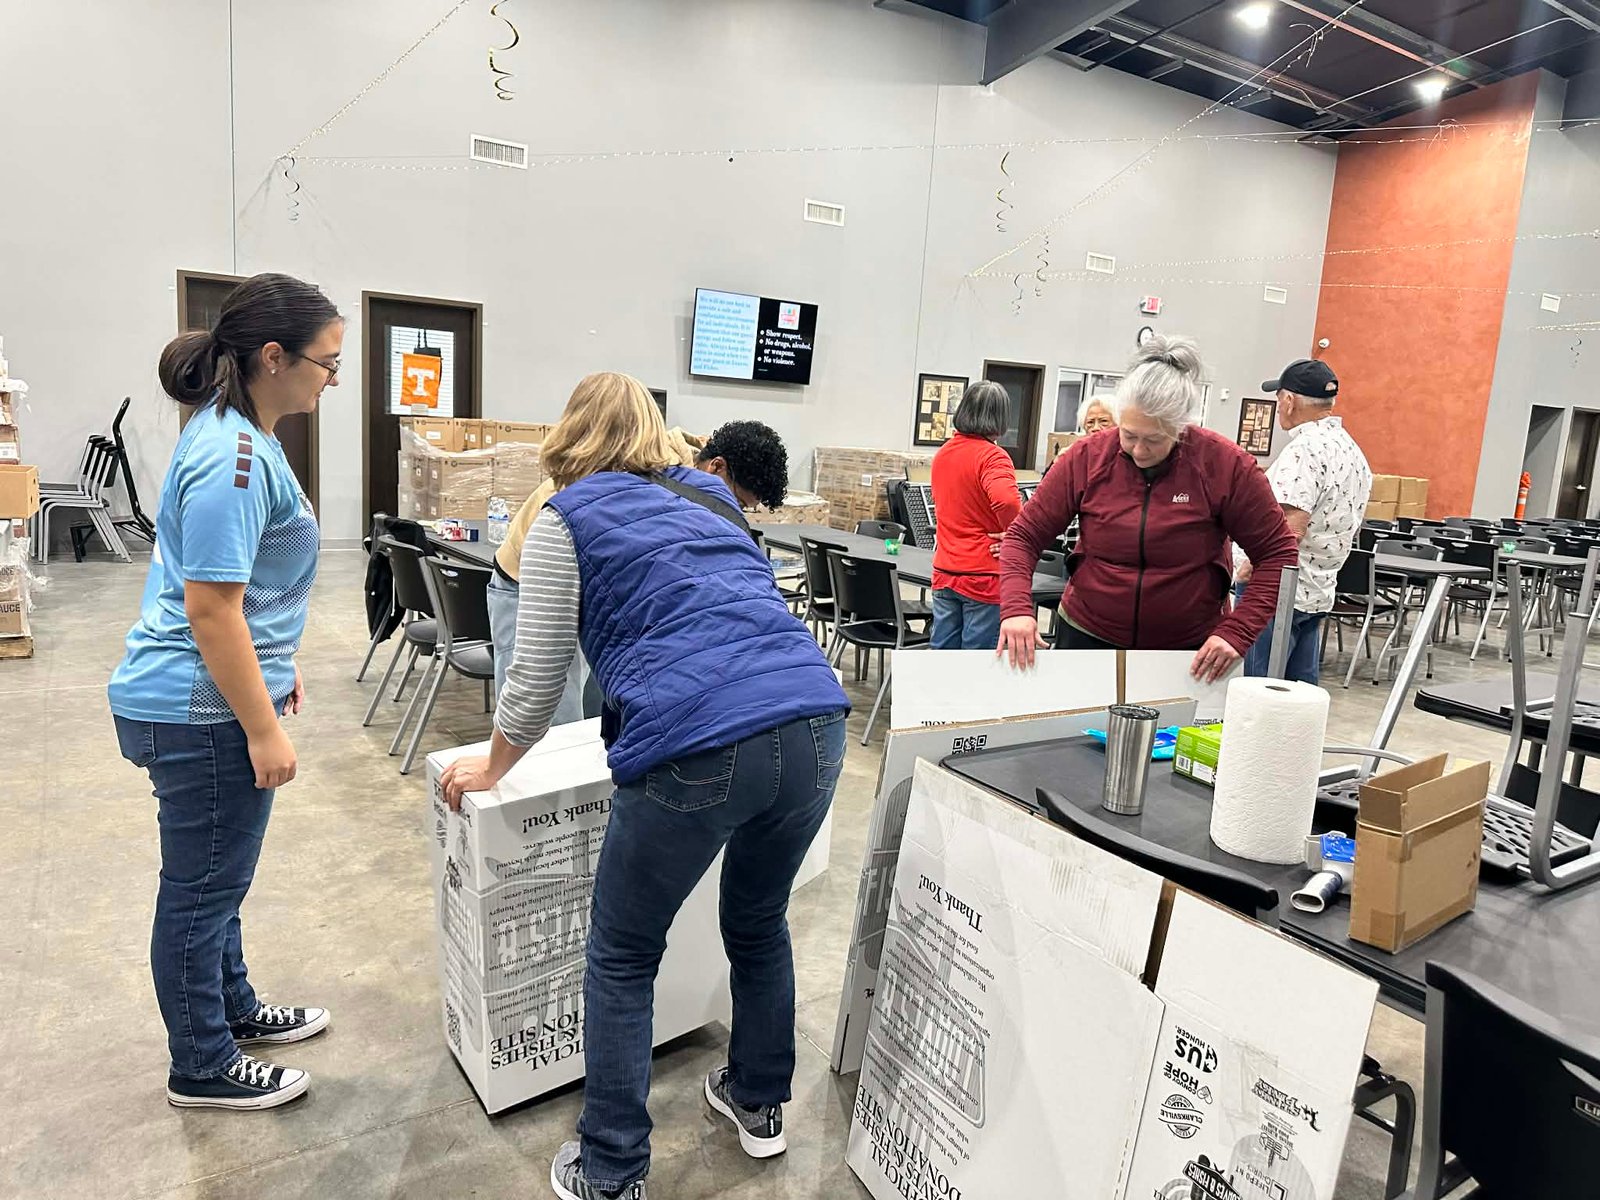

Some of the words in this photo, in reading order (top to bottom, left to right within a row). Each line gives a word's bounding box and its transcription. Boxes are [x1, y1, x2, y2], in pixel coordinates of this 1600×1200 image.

[764, 337, 774, 346] No
[765, 328, 781, 338] Show
[781, 331, 803, 342] respect.
[763, 355, 772, 363] No
[407, 367, 435, 396] T
[521, 809, 561, 835] You!
[917, 870, 944, 905] You!
[942, 888, 984, 935] Thank
[489, 1024, 536, 1055] SITE
[560, 1026, 576, 1045] &
[490, 1033, 556, 1070] FISHES
[1174, 1034, 1203, 1069] U.S.
[1162, 1061, 1199, 1088] HOPE
[1171, 1076, 1198, 1095] CONVOY
[856, 1082, 884, 1126] SITE
[1160, 1109, 1203, 1124] CLARKSVILLE
[853, 1100, 891, 1156] FISHES
[868, 1139, 920, 1200] FFICIAL
[890, 1142, 905, 1171] &
[904, 1158, 945, 1200] AVES
[1188, 1163, 1211, 1189] FISHES
